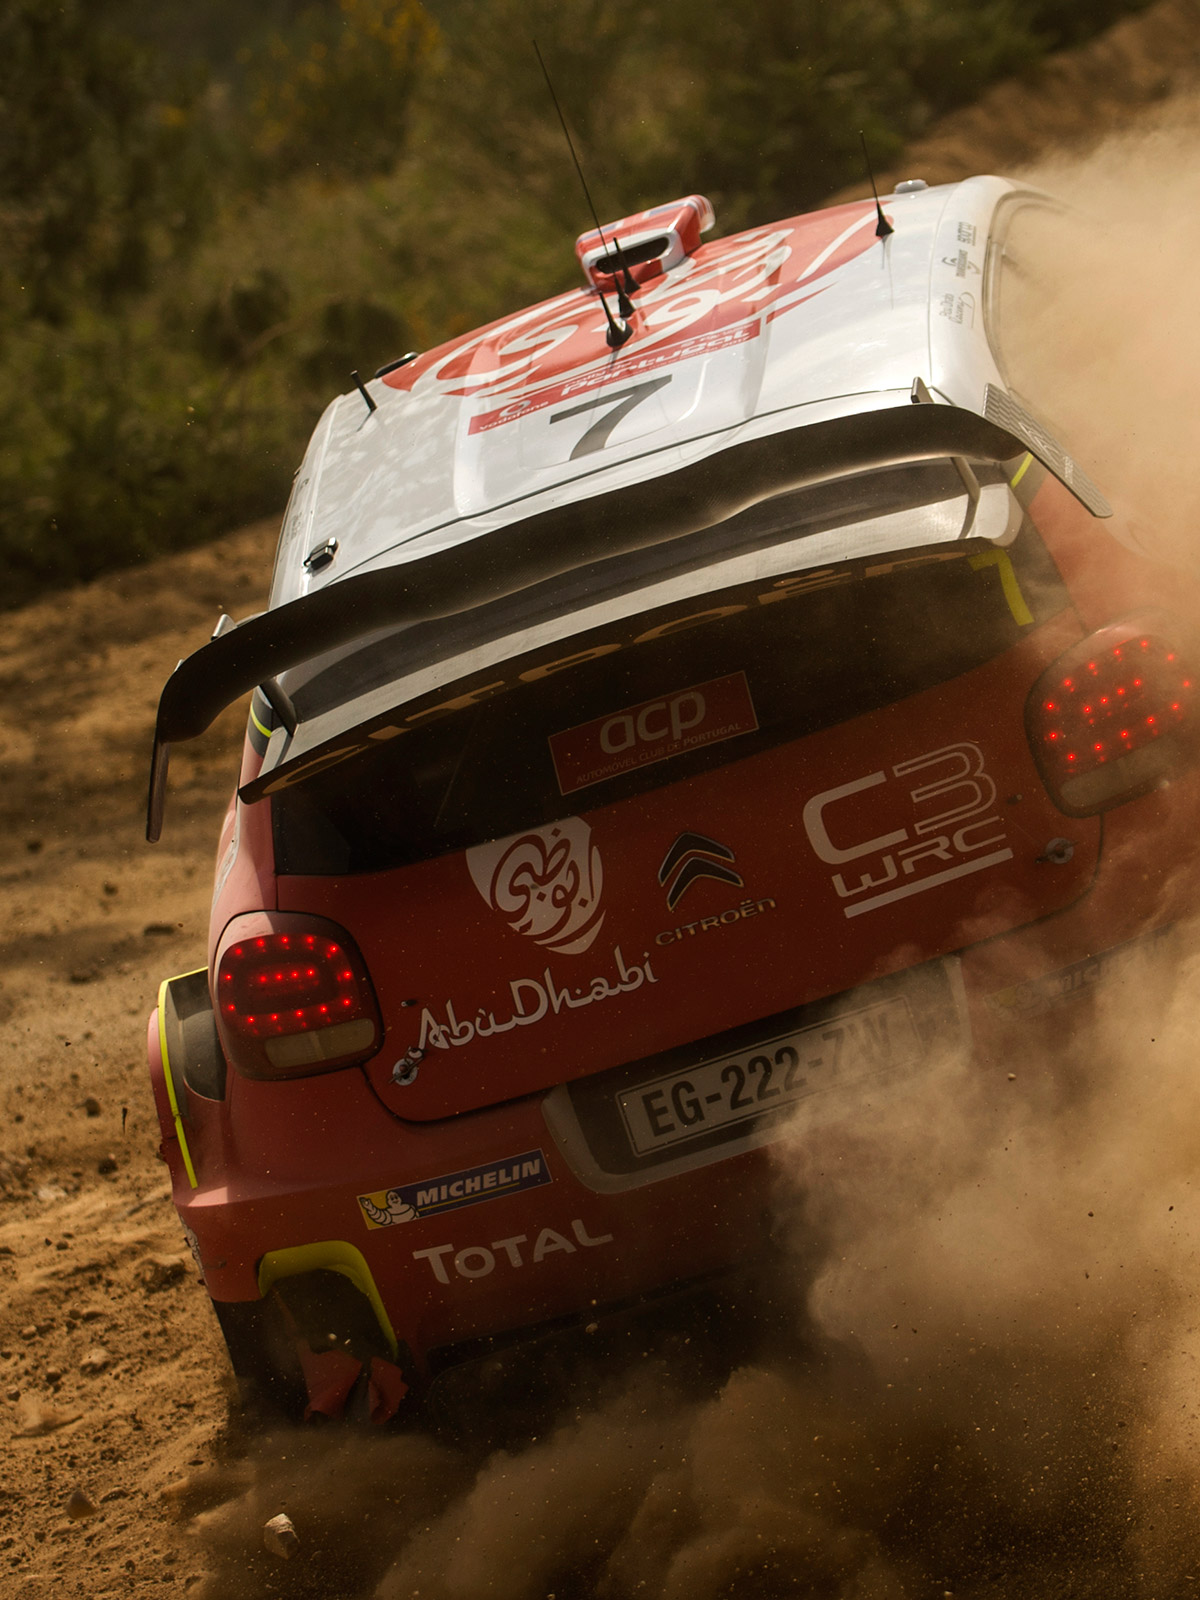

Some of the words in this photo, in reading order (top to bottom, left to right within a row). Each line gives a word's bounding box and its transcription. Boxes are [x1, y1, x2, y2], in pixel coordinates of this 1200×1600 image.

[479, 400, 549, 430] vodafone
[549, 374, 673, 461] 7
[600, 691, 706, 754] acp
[683, 722, 741, 745] PORTUGAL
[803, 742, 996, 865] C3
[831, 816, 1006, 897] WRC
[417, 1158, 541, 1207] MICHELIN
[412, 1219, 614, 1285] TOTAL
